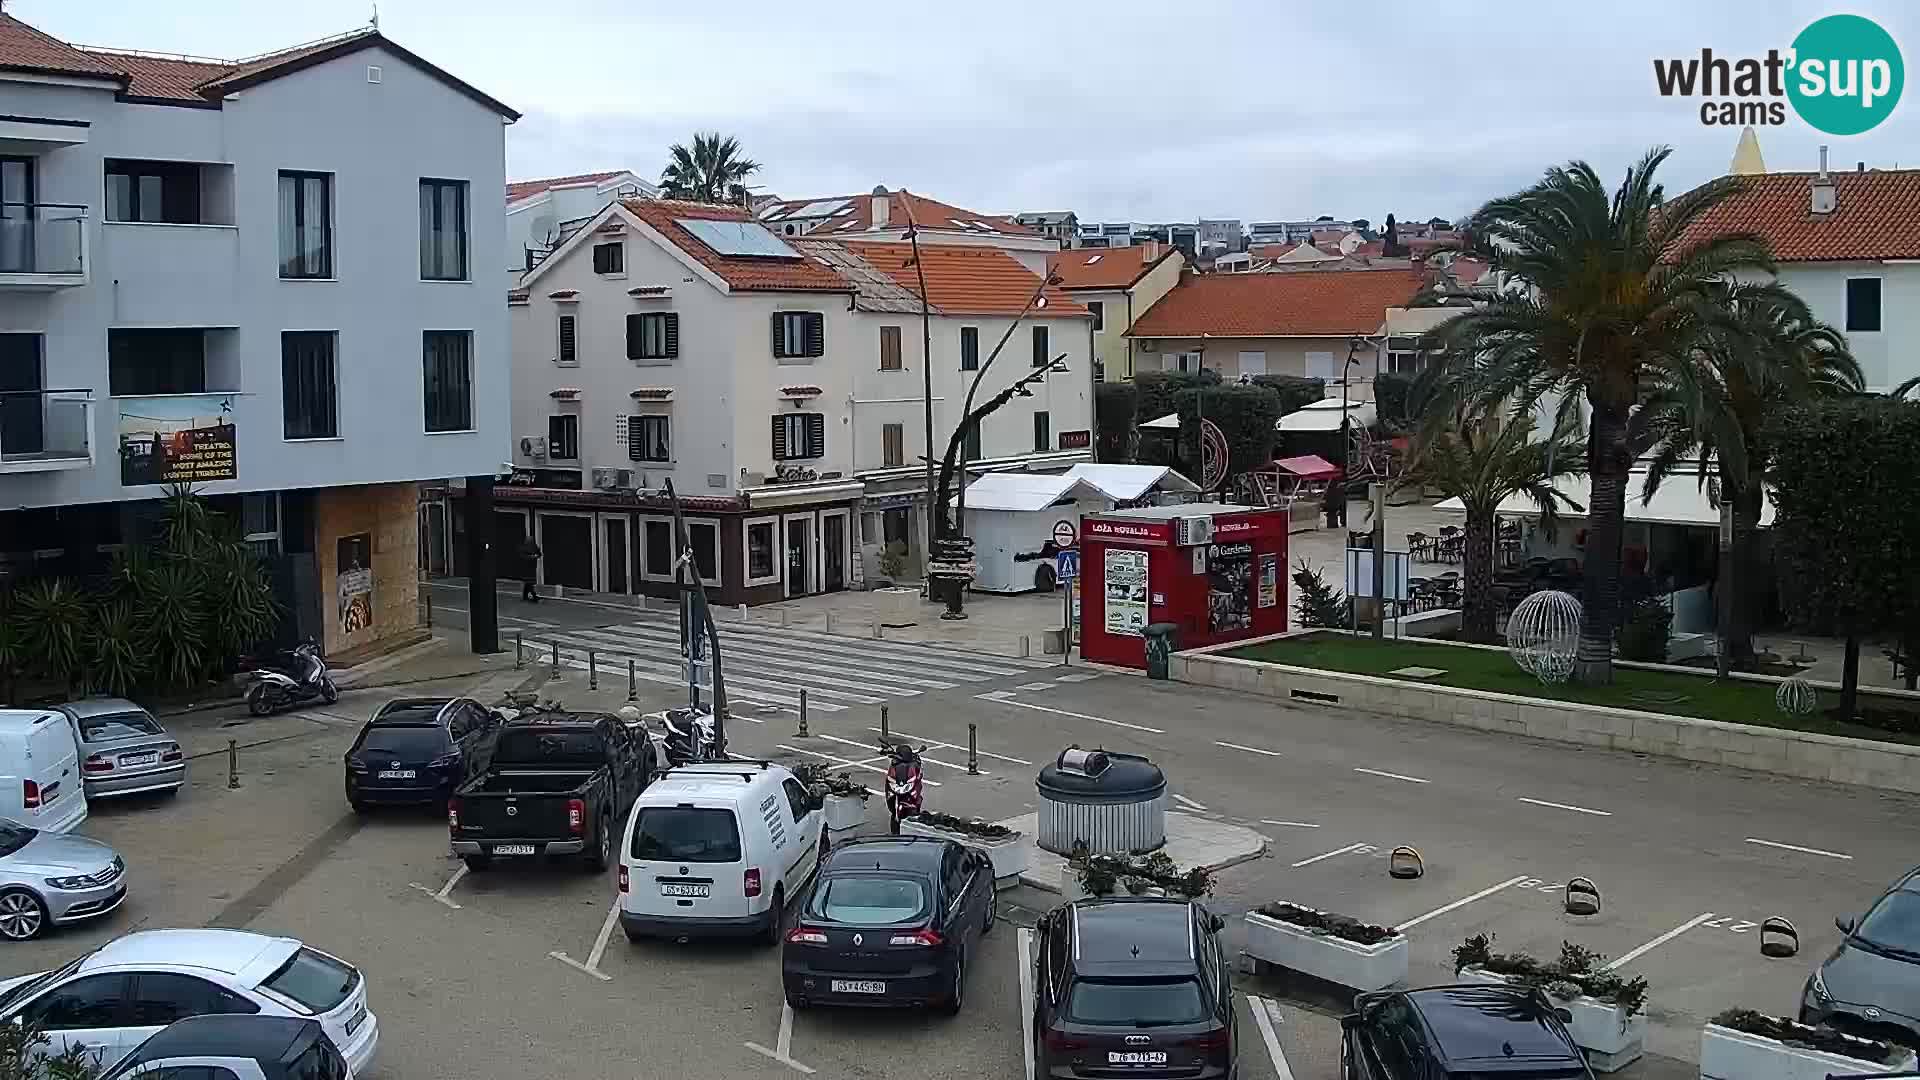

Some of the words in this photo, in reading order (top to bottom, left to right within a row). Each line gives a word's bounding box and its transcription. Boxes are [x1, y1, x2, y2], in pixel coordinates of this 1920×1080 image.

[172, 462, 195, 470] MOST
[196, 460, 233, 468] AMAZING
[837, 981, 849, 991] GS
